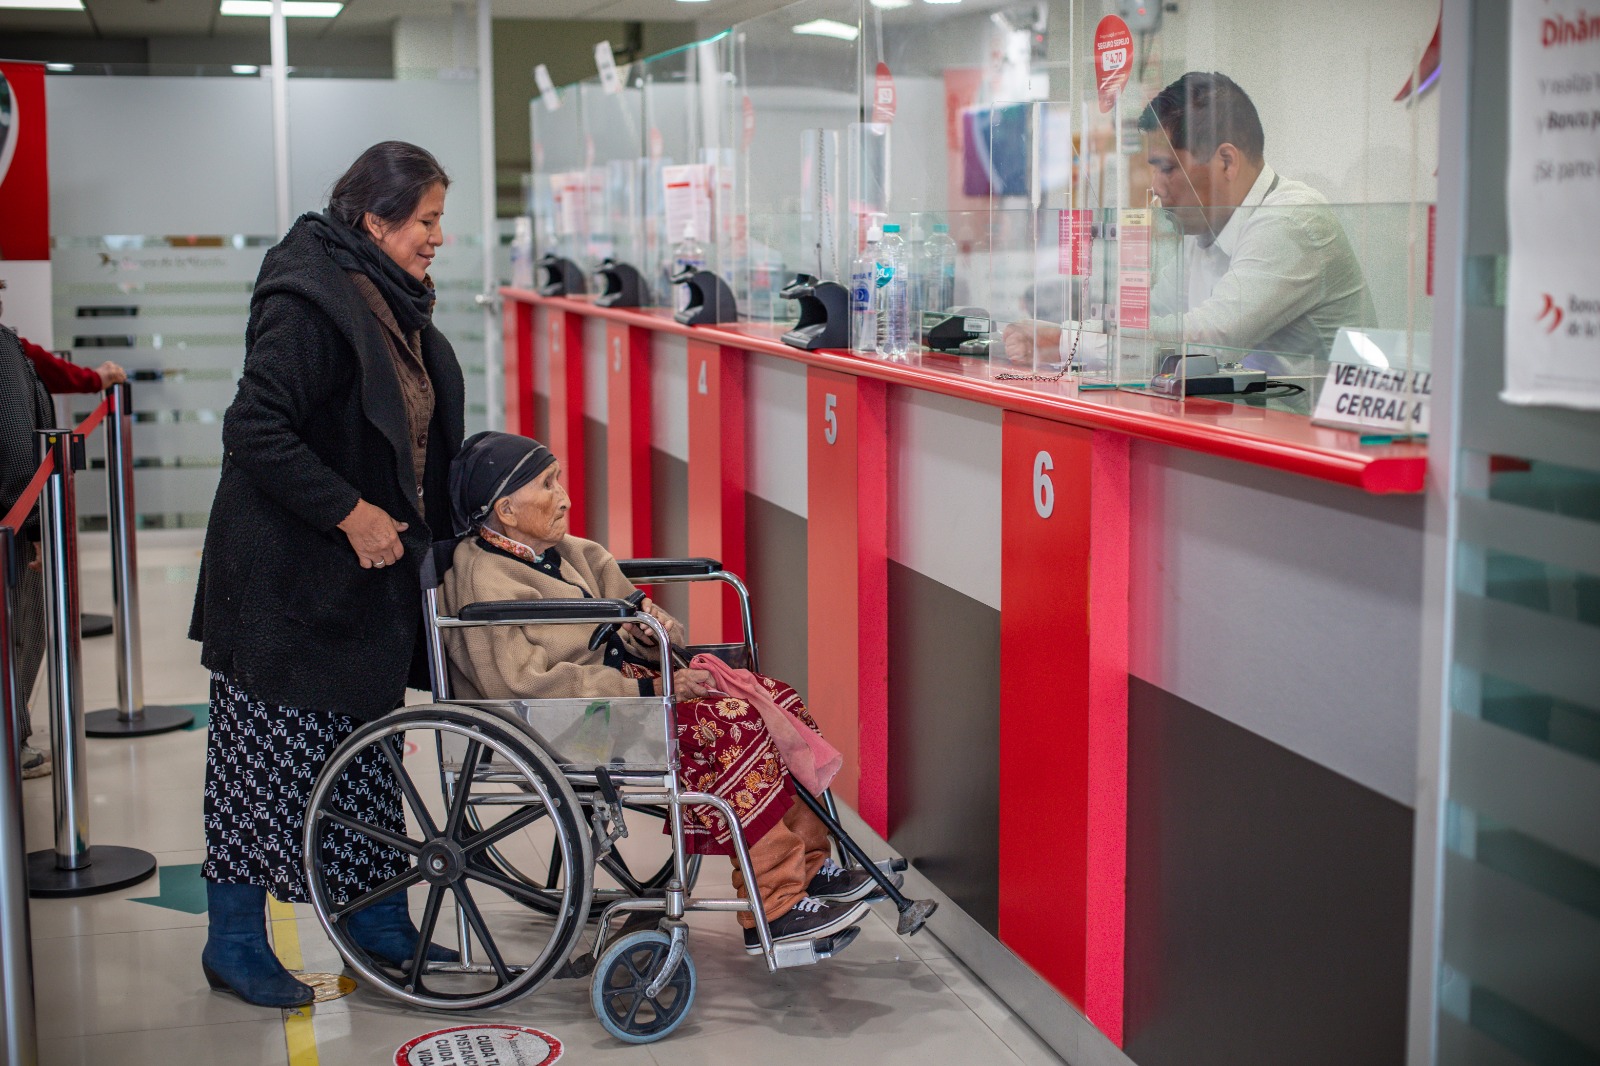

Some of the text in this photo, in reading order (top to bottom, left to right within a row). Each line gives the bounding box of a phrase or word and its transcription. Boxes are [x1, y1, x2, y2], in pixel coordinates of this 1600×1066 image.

[613, 336, 621, 372] 3
[698, 359, 708, 394] 4
[824, 393, 837, 445] 5
[1033, 450, 1054, 519] 6
[435, 1039, 454, 1062] CUIDA
[476, 1035, 496, 1058] CUIDA
